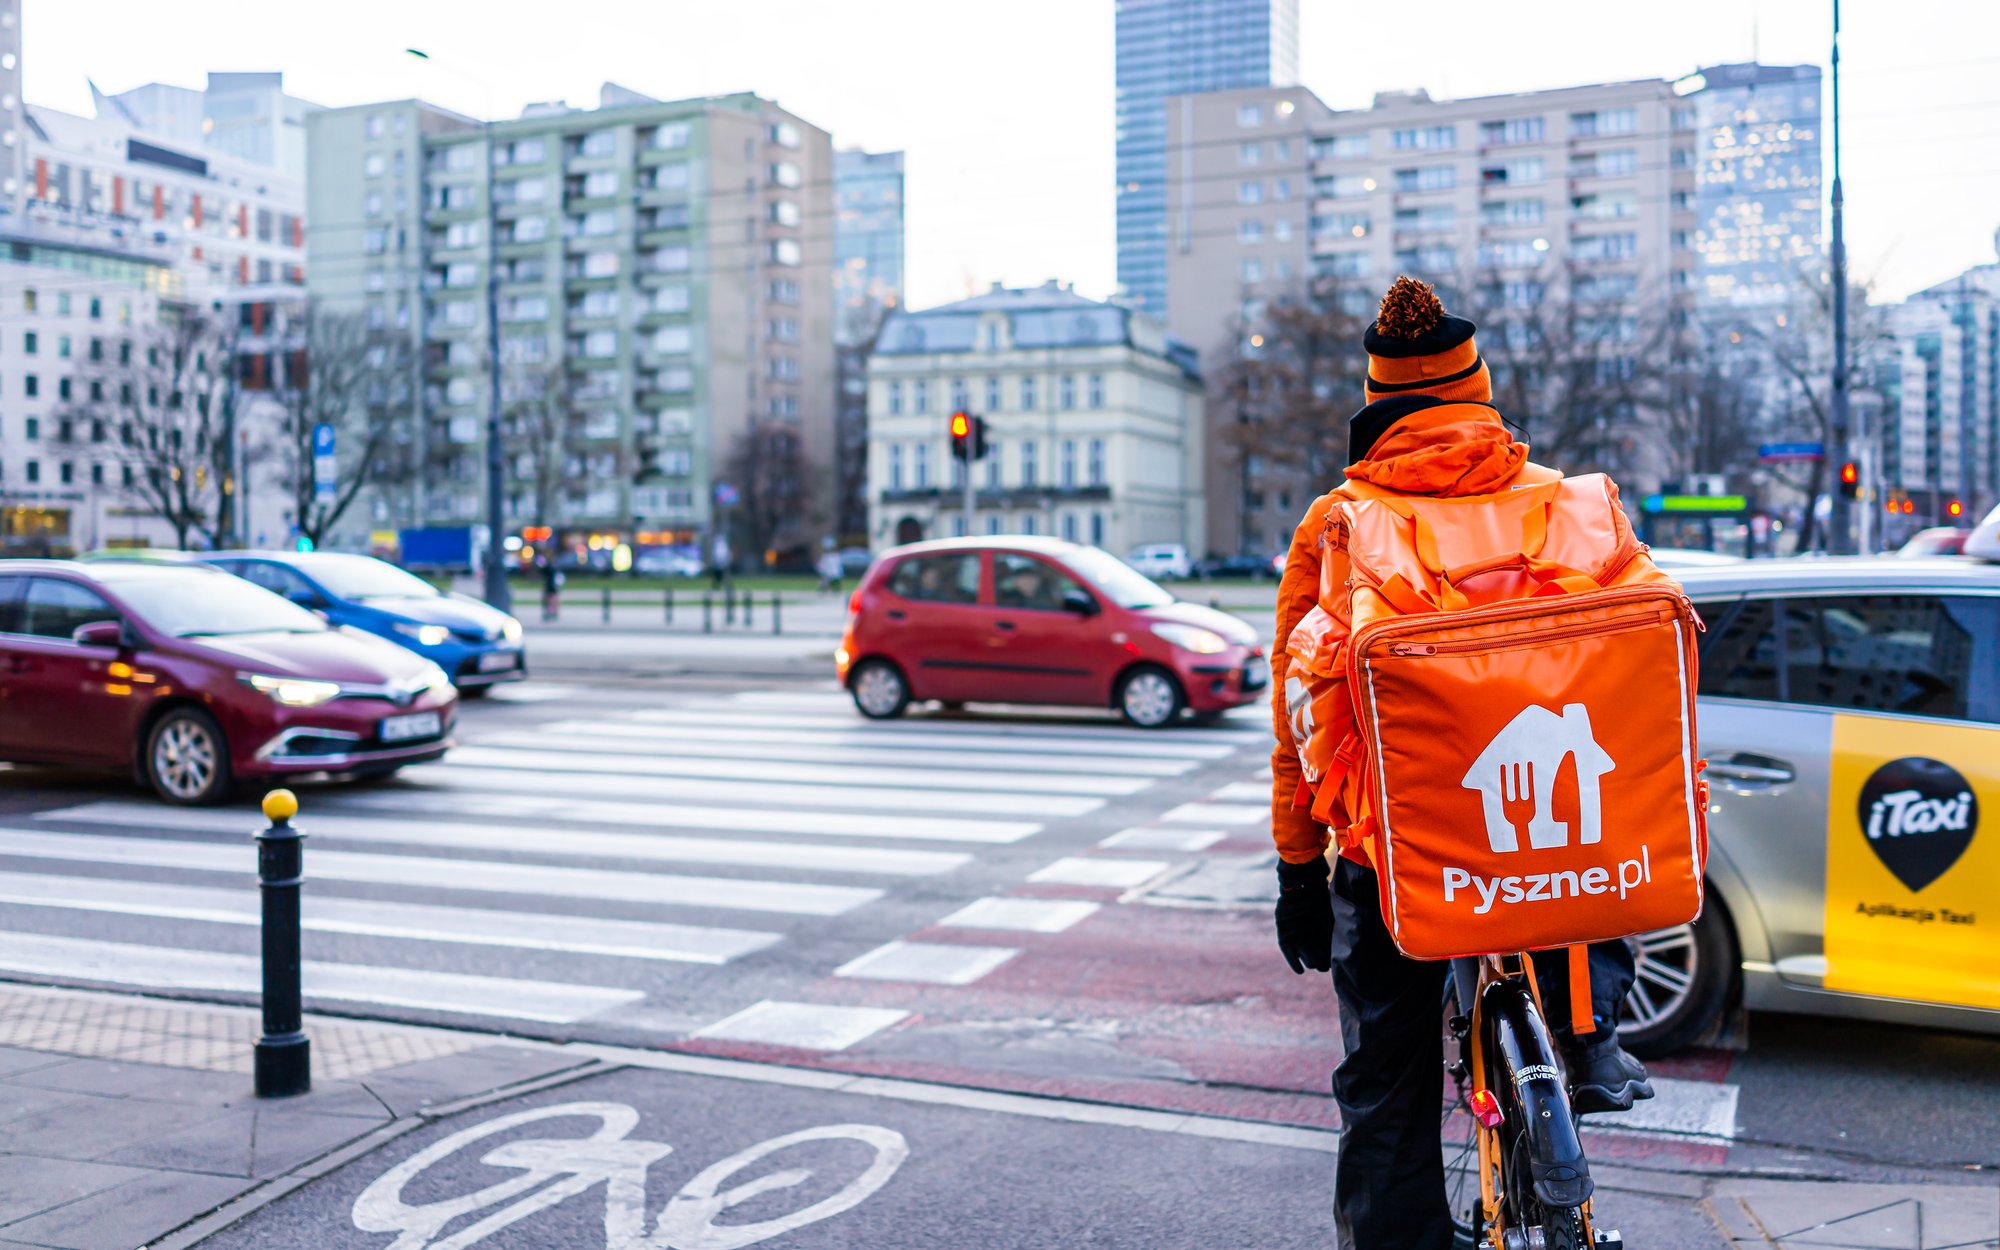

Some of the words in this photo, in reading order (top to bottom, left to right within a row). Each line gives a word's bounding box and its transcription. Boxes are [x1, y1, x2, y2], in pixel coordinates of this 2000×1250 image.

[1867, 790, 1972, 839] iTaxi
[1442, 845, 1652, 914] Pyszne.pl
[1856, 902, 1934, 923] Aplikacja
[1939, 908, 1976, 924] Taxi
[1517, 1073, 1558, 1086] DELIVERY
